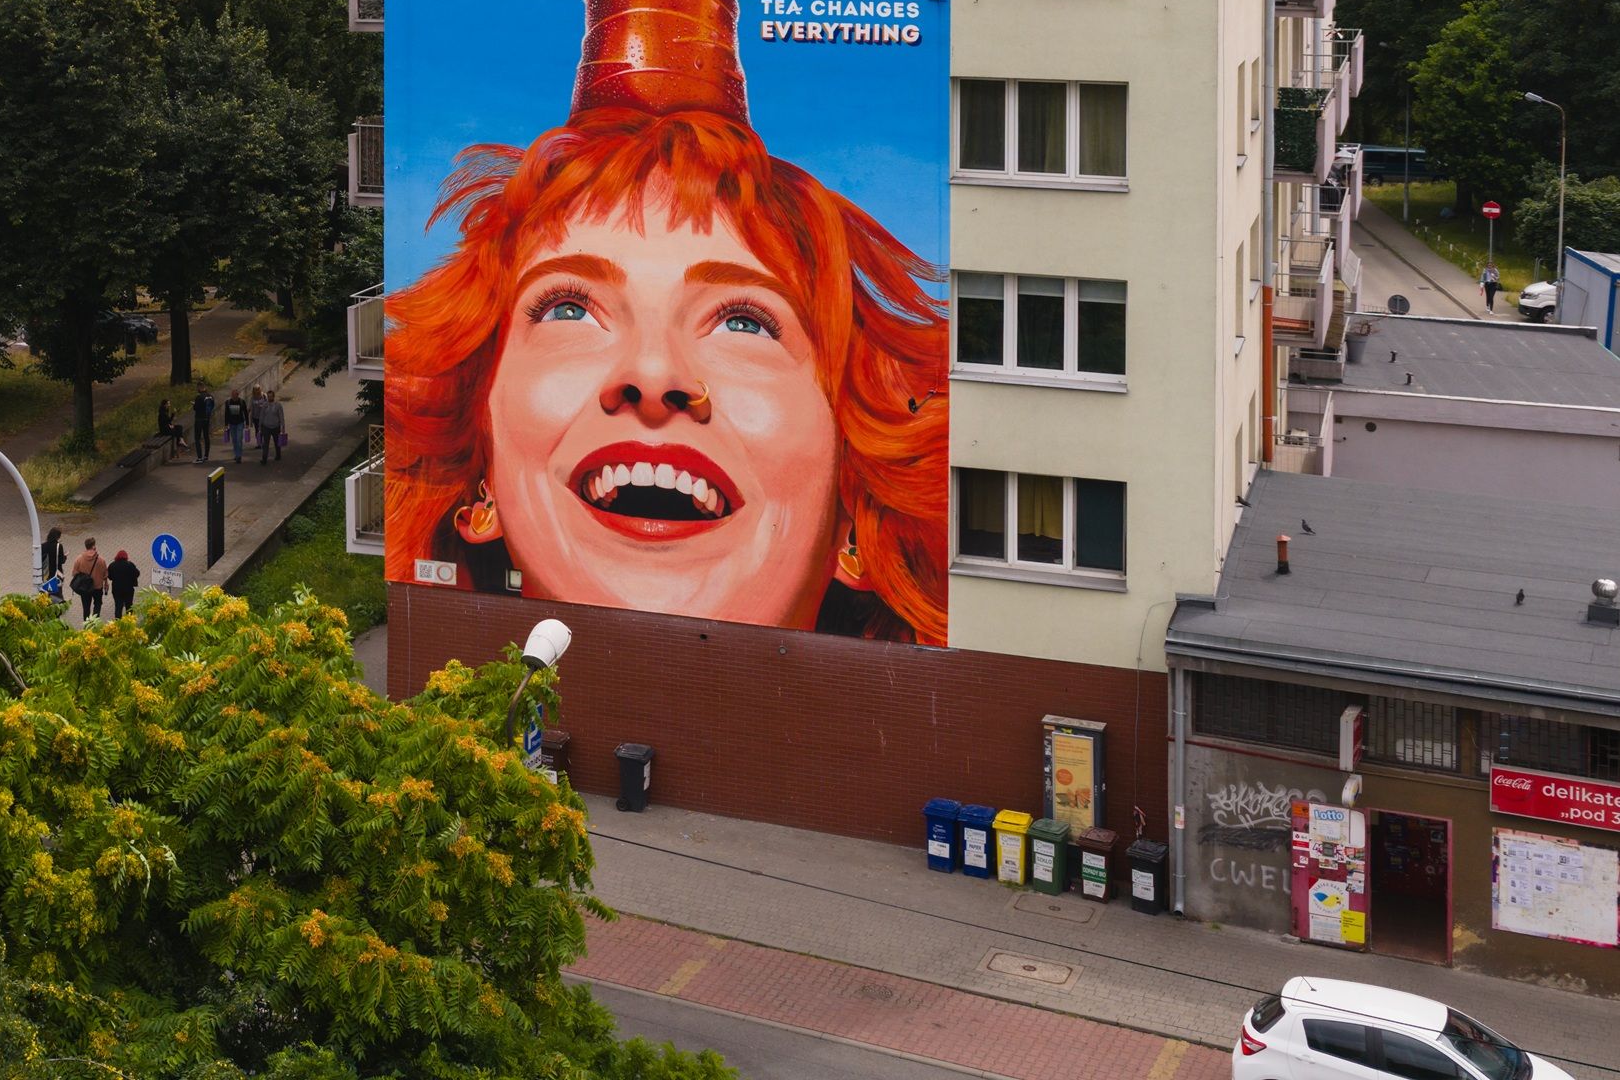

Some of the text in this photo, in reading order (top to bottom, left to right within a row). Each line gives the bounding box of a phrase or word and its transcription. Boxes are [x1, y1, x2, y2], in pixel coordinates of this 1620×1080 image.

[761, 0, 920, 18] TEA CHANGES
[761, 21, 921, 45] EVERYTHING
[1314, 809, 1345, 821] Lotto
